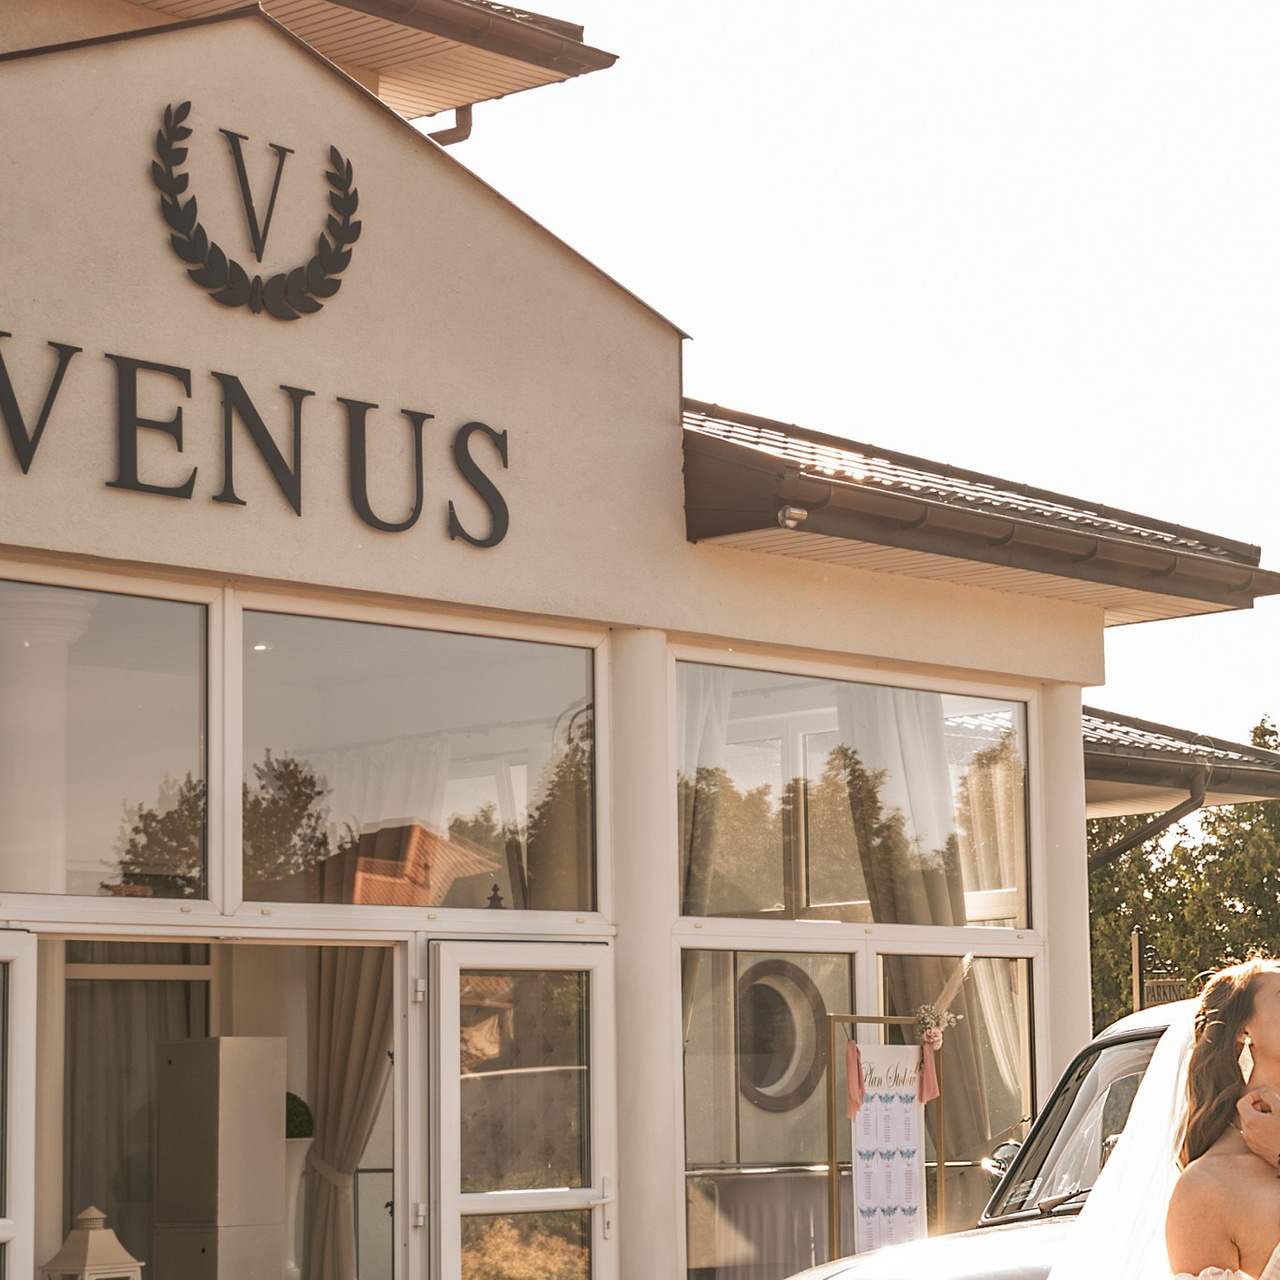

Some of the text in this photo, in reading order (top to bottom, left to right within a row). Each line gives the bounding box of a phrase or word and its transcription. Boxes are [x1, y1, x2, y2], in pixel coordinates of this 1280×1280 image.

[219, 127, 295, 263] V
[0, 331, 510, 549] VENUS
[1146, 983, 1186, 1002] PARKING
[862, 1061, 883, 1088] Plan
